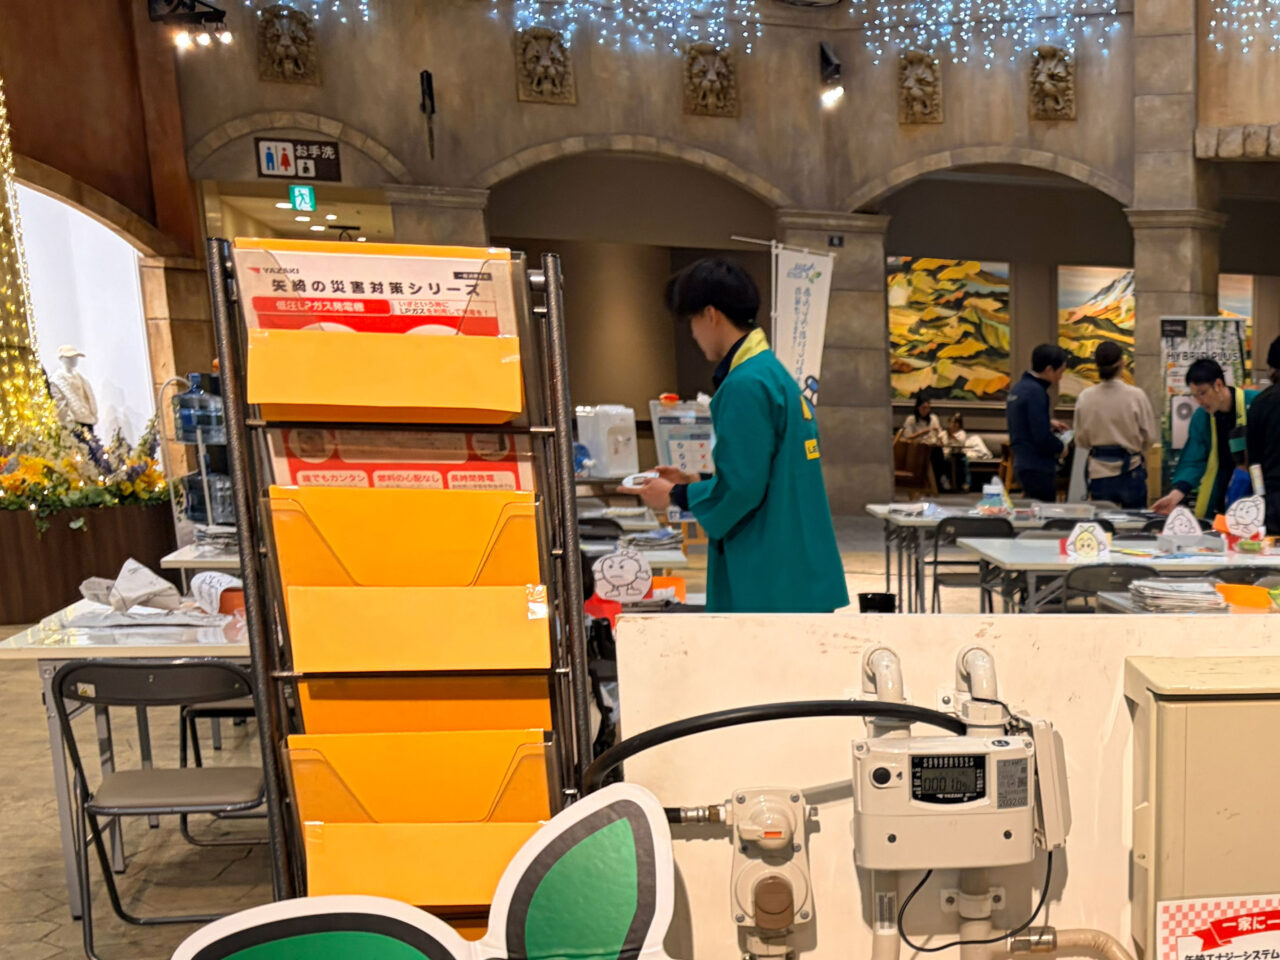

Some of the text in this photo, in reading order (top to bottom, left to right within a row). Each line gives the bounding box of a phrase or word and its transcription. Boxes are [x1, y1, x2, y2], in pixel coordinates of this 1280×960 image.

[296, 144, 336, 159] お手洗
[272, 279, 480, 296] 矢崎の災害対策シリーズ
